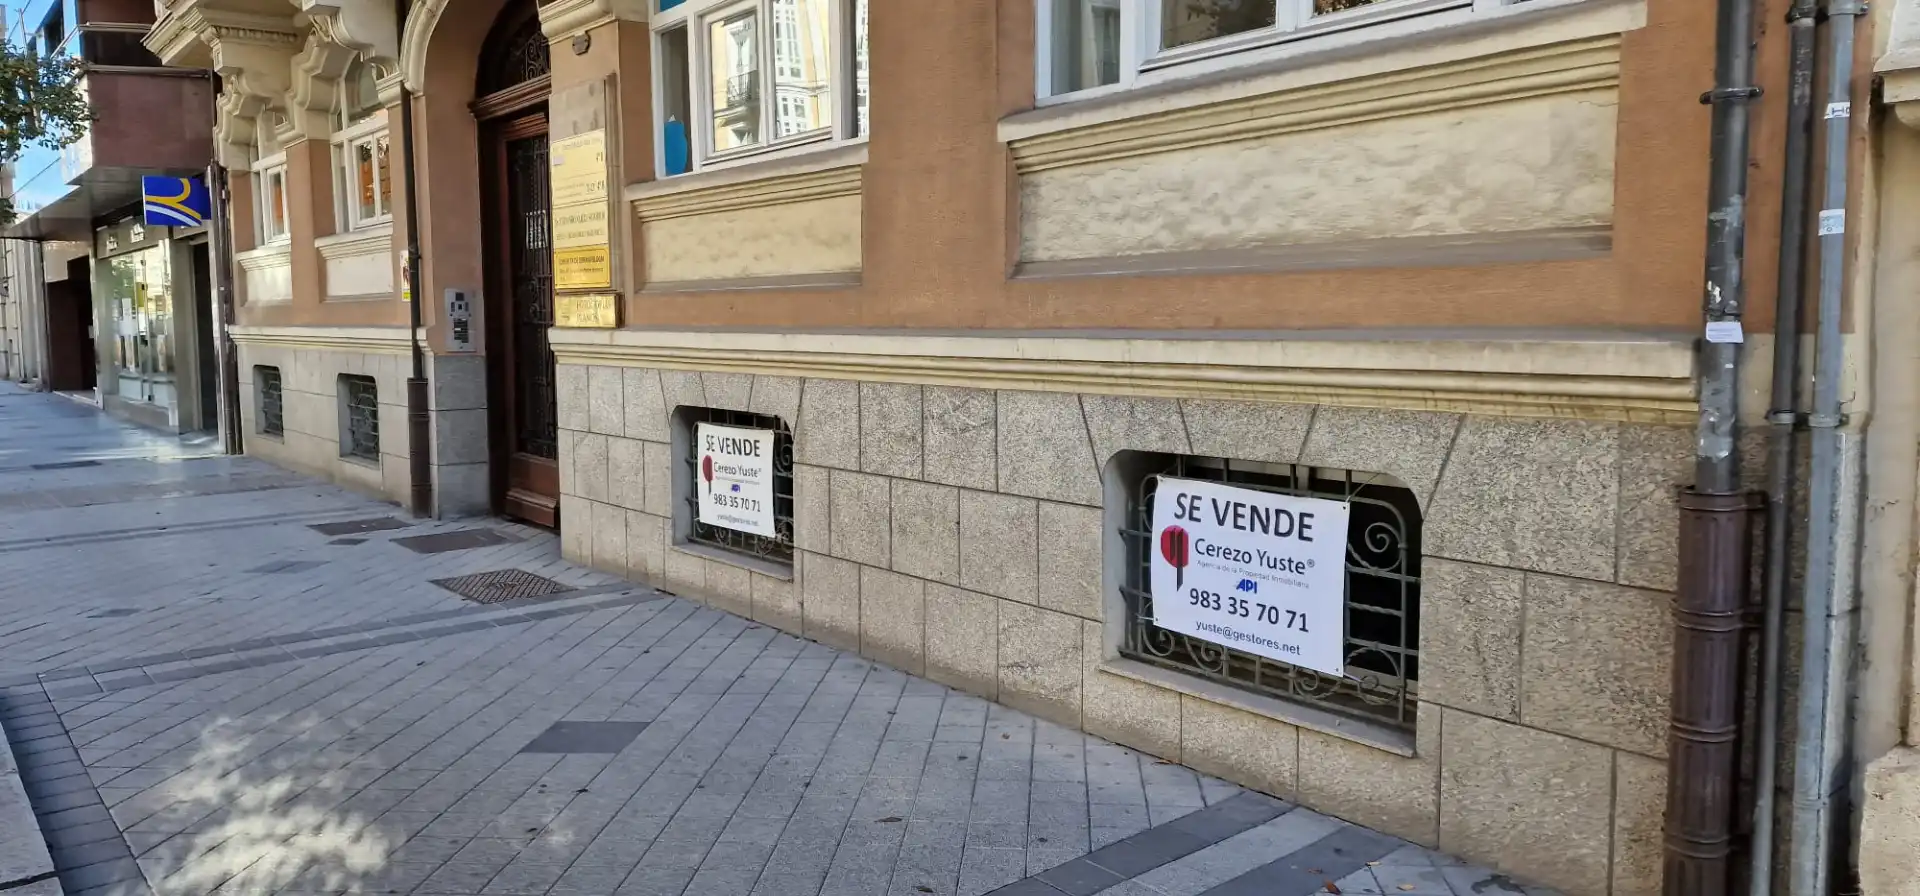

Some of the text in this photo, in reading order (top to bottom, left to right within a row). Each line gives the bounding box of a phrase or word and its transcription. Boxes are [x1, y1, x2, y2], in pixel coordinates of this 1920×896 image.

[706, 434, 761, 457] SE VENDE
[714, 461, 736, 475] Cerezo
[713, 493, 761, 512] 983 35 70 71
[1173, 492, 1315, 542] SE VENDE
[1194, 538, 1252, 565] Cerezo
[1196, 559, 1221, 571] Agencia
[1221, 565, 1231, 573] de
[1239, 567, 1270, 581] Propiedad
[1236, 578, 1258, 594] API
[1189, 587, 1309, 633] 983 35 70 71
[1195, 621, 1301, 656] yuste@gestores.net
